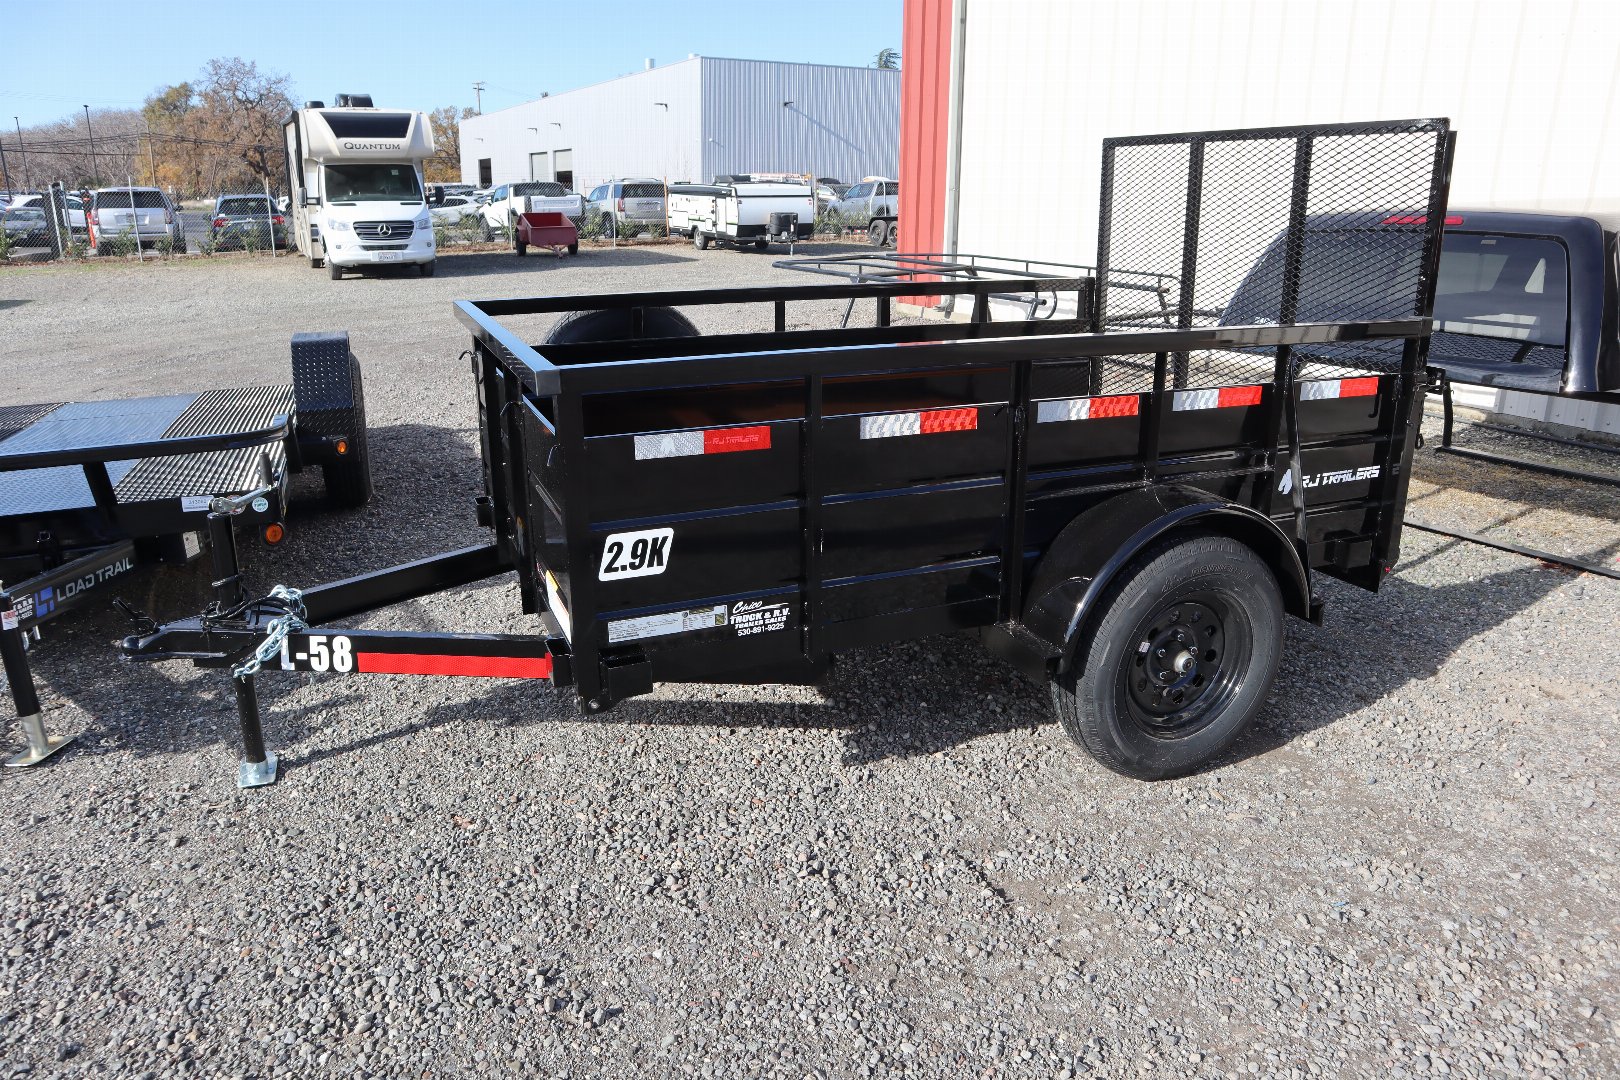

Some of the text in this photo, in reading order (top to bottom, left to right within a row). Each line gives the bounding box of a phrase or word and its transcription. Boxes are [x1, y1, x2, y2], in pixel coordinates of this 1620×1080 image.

[343, 142, 401, 150] QUANTUM
[1322, 465, 1381, 486] TRAILERS
[603, 535, 669, 573] 2.9K
[56, 557, 134, 602] LOAD TRAIL
[730, 611, 763, 625] TRUCK
[763, 611, 772, 619] &
[734, 615, 787, 629] TRAILER SALES
[737, 622, 785, 637] 530-891-9225
